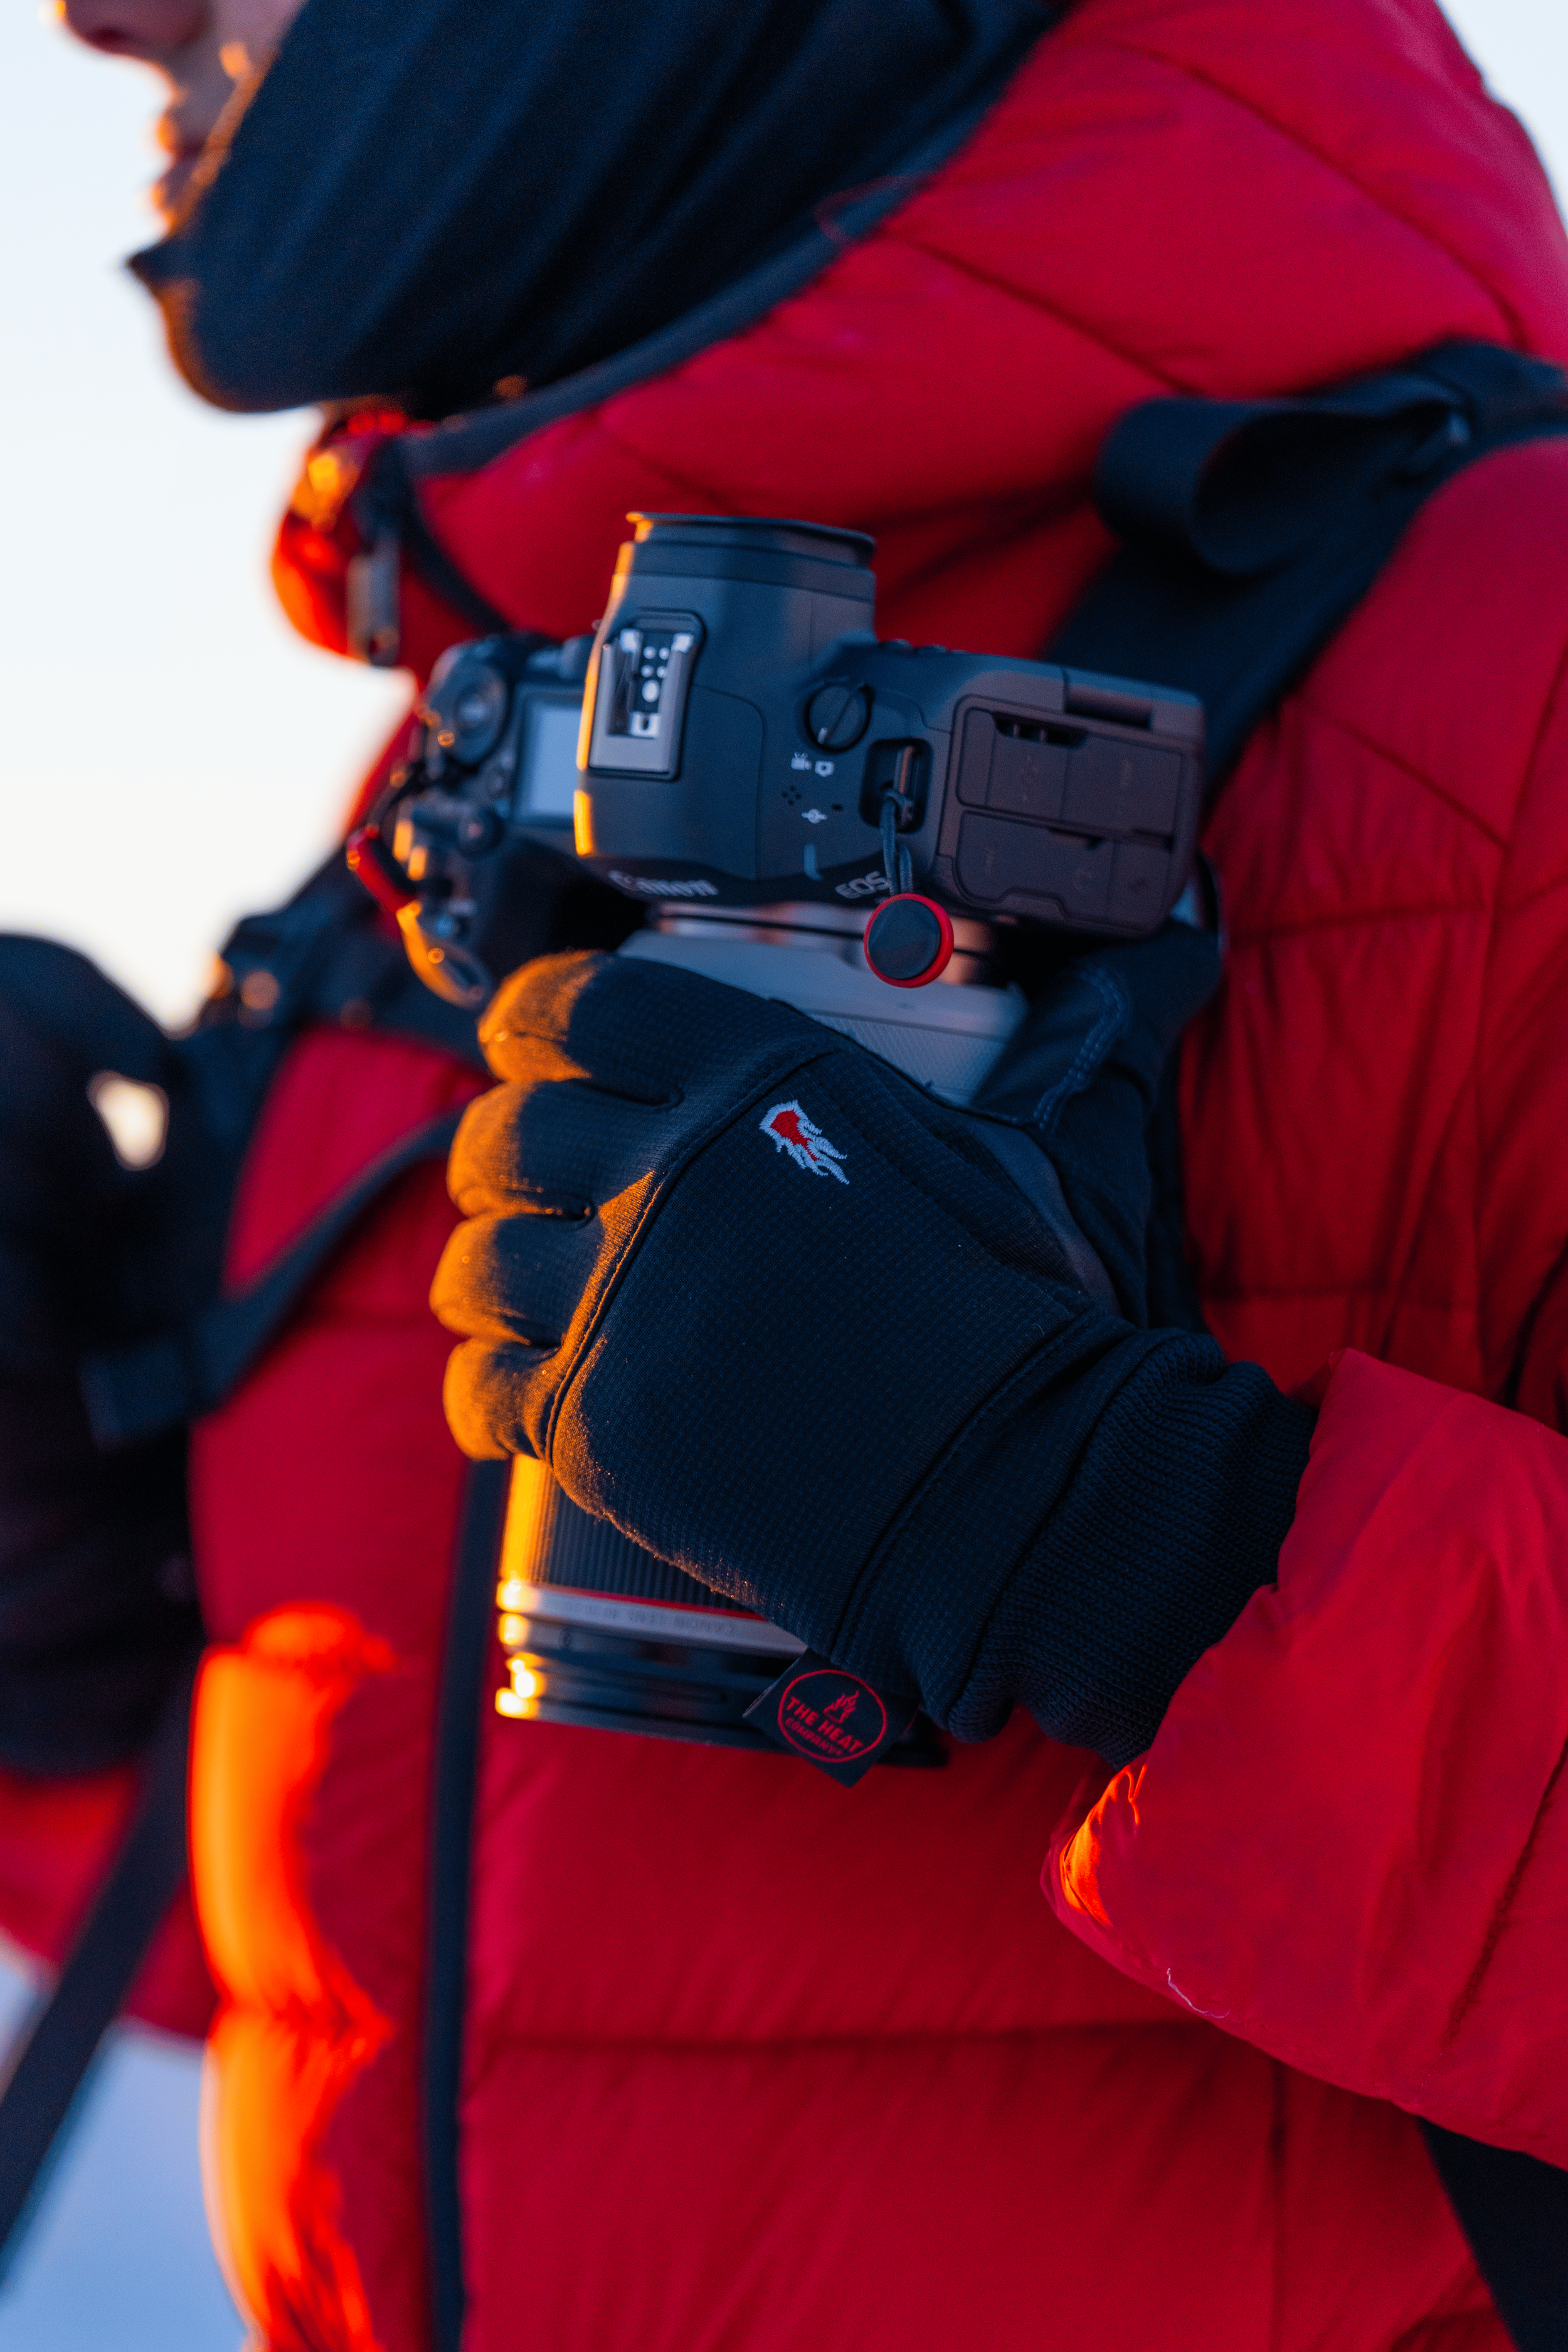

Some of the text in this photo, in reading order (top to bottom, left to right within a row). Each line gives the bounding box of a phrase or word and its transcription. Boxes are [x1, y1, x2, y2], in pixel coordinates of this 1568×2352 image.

[608, 871, 719, 897] Canon
[835, 871, 891, 899] EOS
[787, 1696, 863, 1752] THE HEAT
